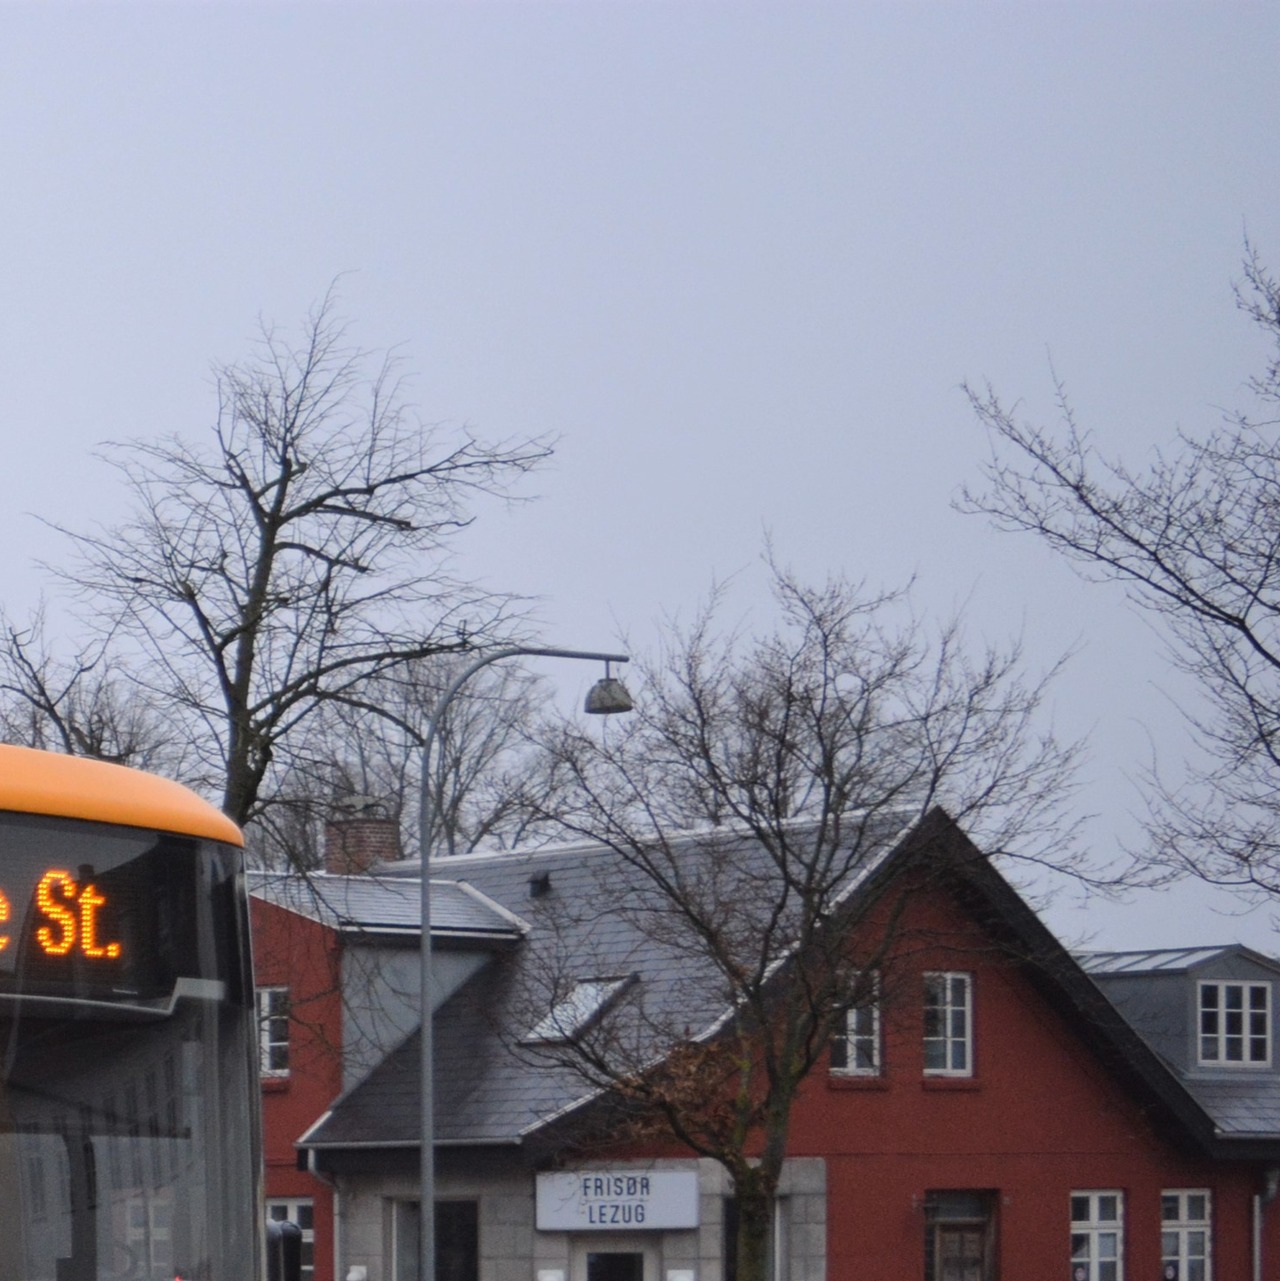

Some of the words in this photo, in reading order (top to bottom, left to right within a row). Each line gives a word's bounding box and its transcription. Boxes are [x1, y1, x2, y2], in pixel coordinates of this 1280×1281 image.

[37, 868, 122, 957] St.
[582, 1177, 651, 1196] FRISØR
[588, 1204, 646, 1224] LEZUG
